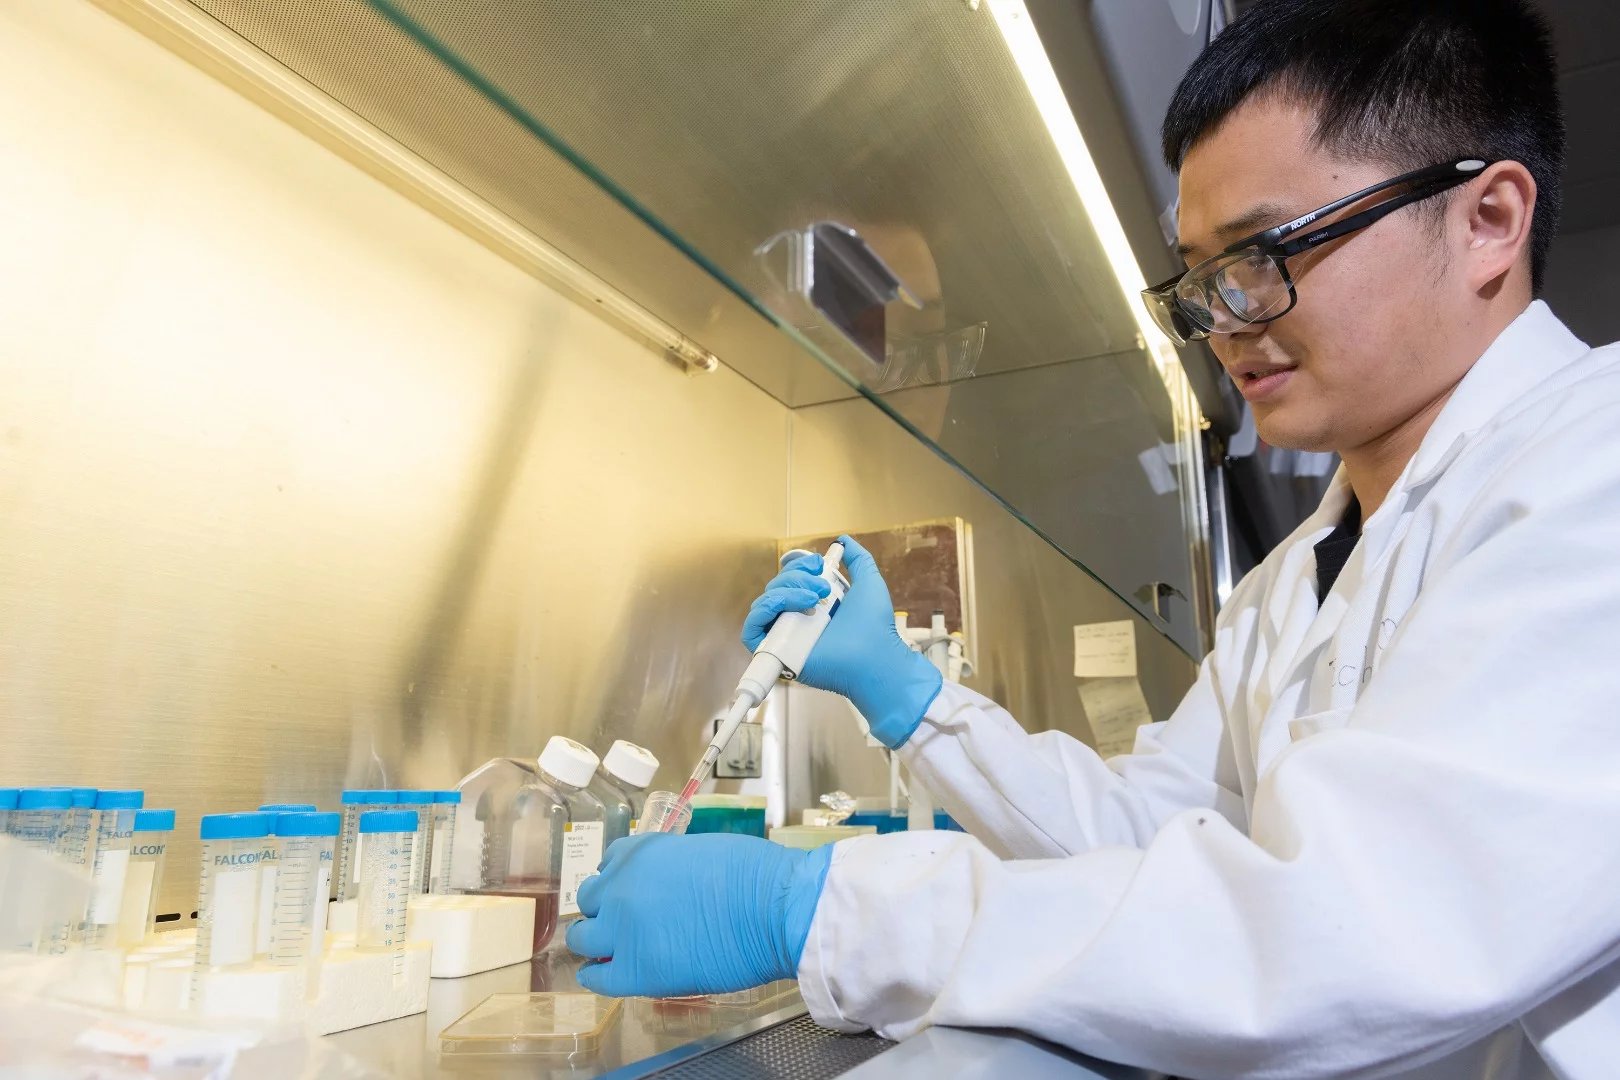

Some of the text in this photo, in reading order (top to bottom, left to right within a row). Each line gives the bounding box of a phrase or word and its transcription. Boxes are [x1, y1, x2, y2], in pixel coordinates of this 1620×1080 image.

[1291, 211, 1316, 231] NORTH
[214, 852, 261, 866] FALCON
[261, 849, 278, 860] AL
